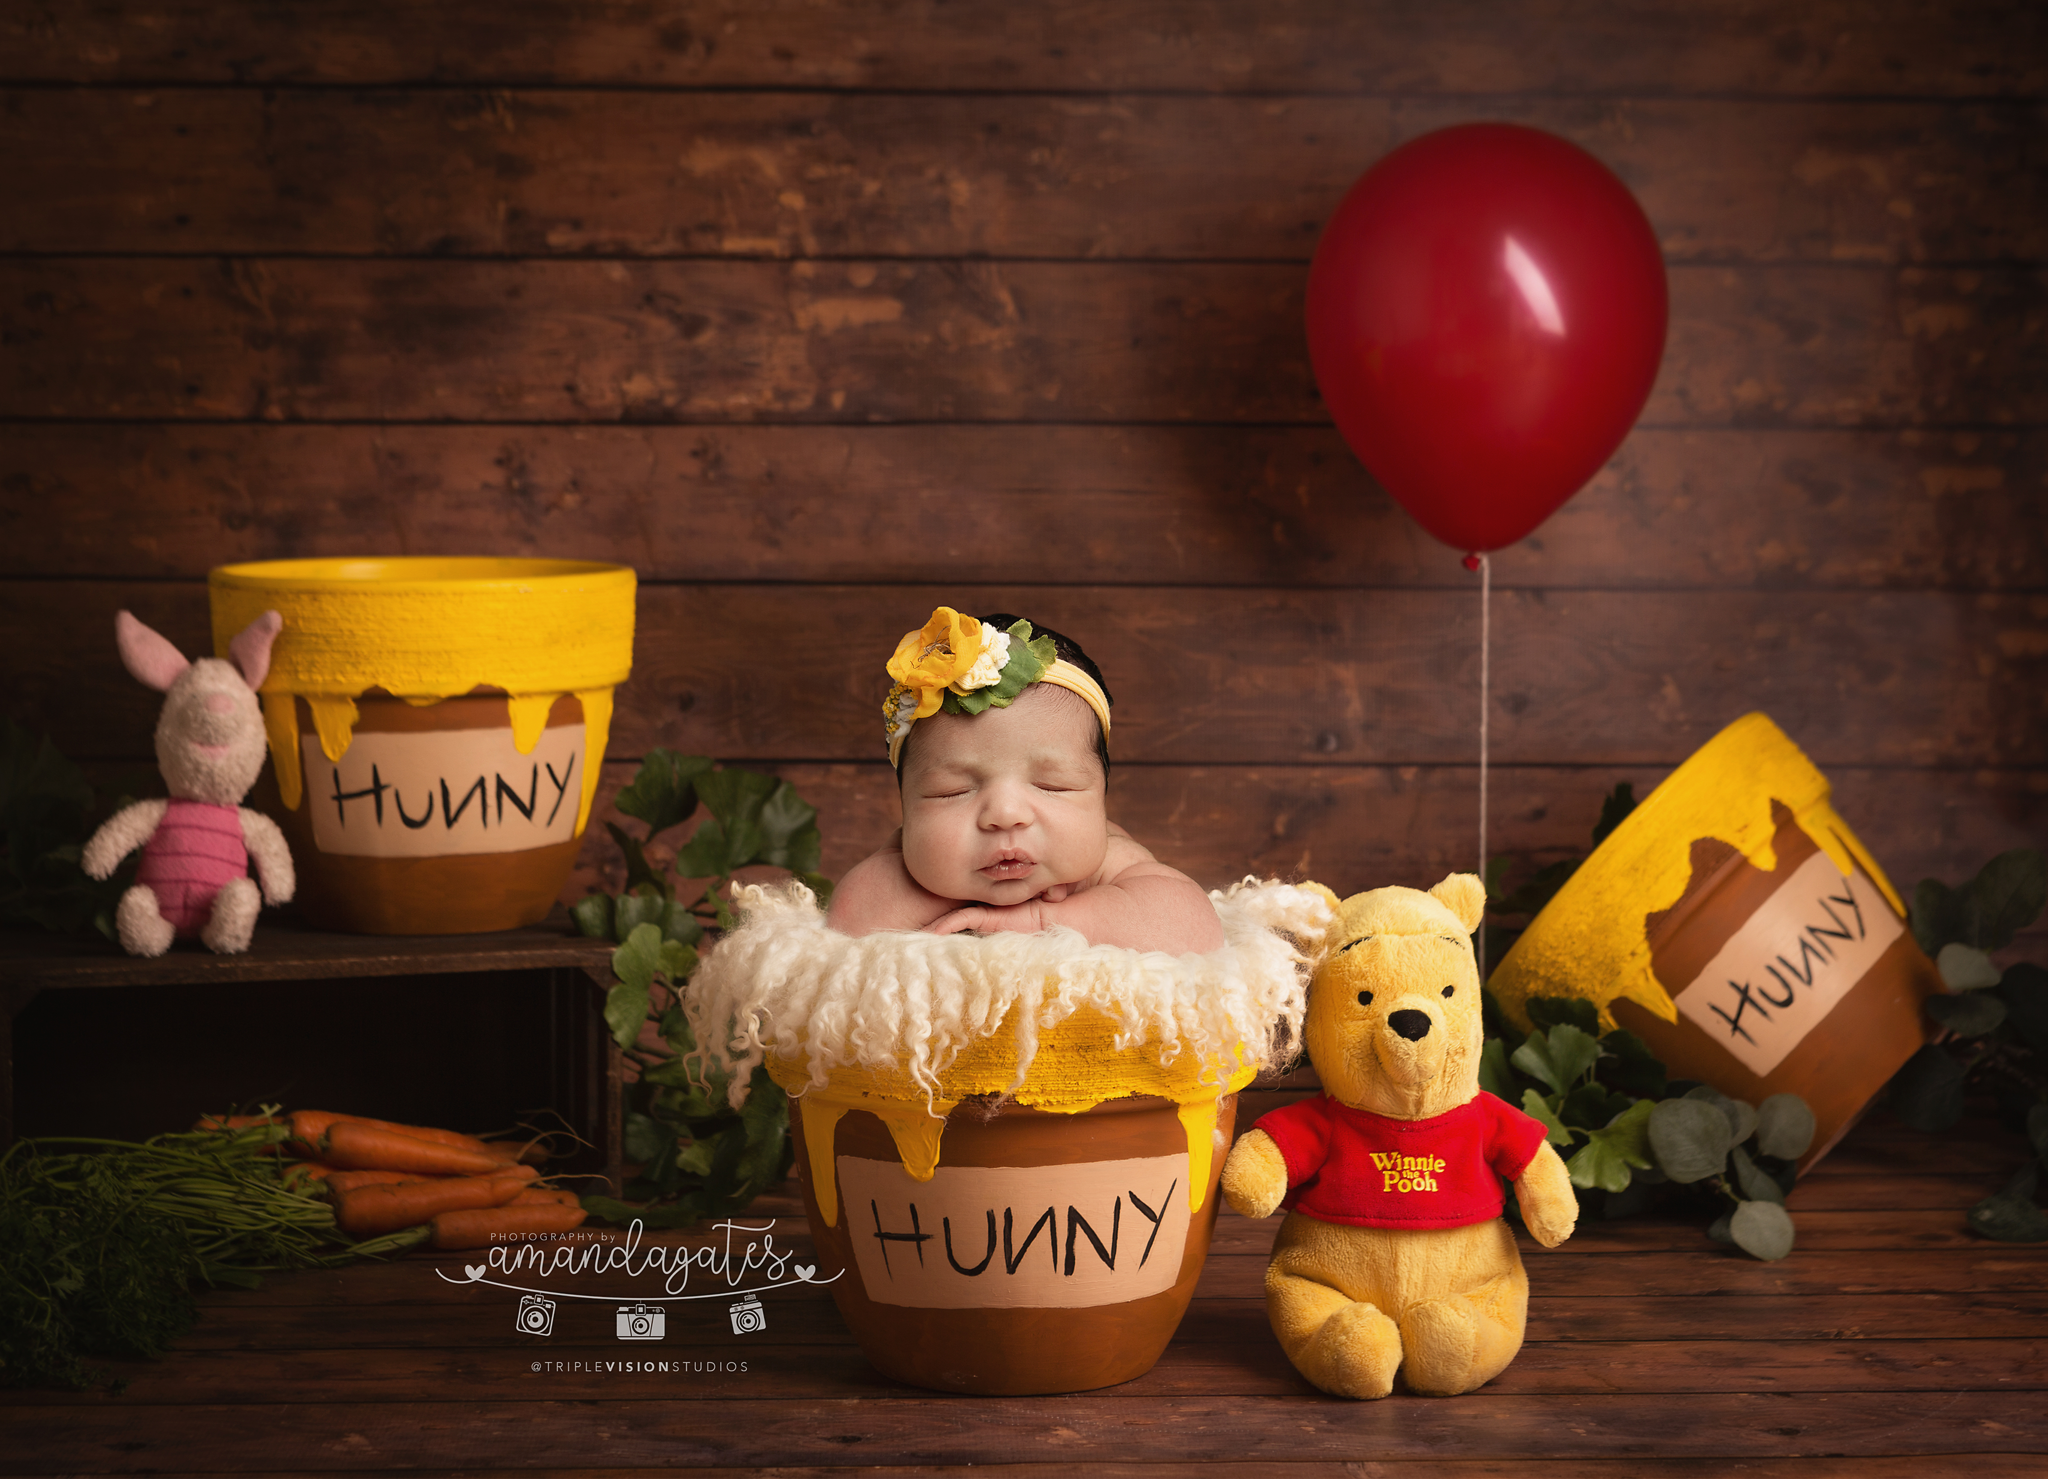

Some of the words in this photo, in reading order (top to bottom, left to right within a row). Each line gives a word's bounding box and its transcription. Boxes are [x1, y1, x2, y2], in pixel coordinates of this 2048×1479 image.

[1369, 1151, 1446, 1172] Winnie
[1382, 1170, 1439, 1193] Pooh
[1402, 1170, 1420, 1179] the
